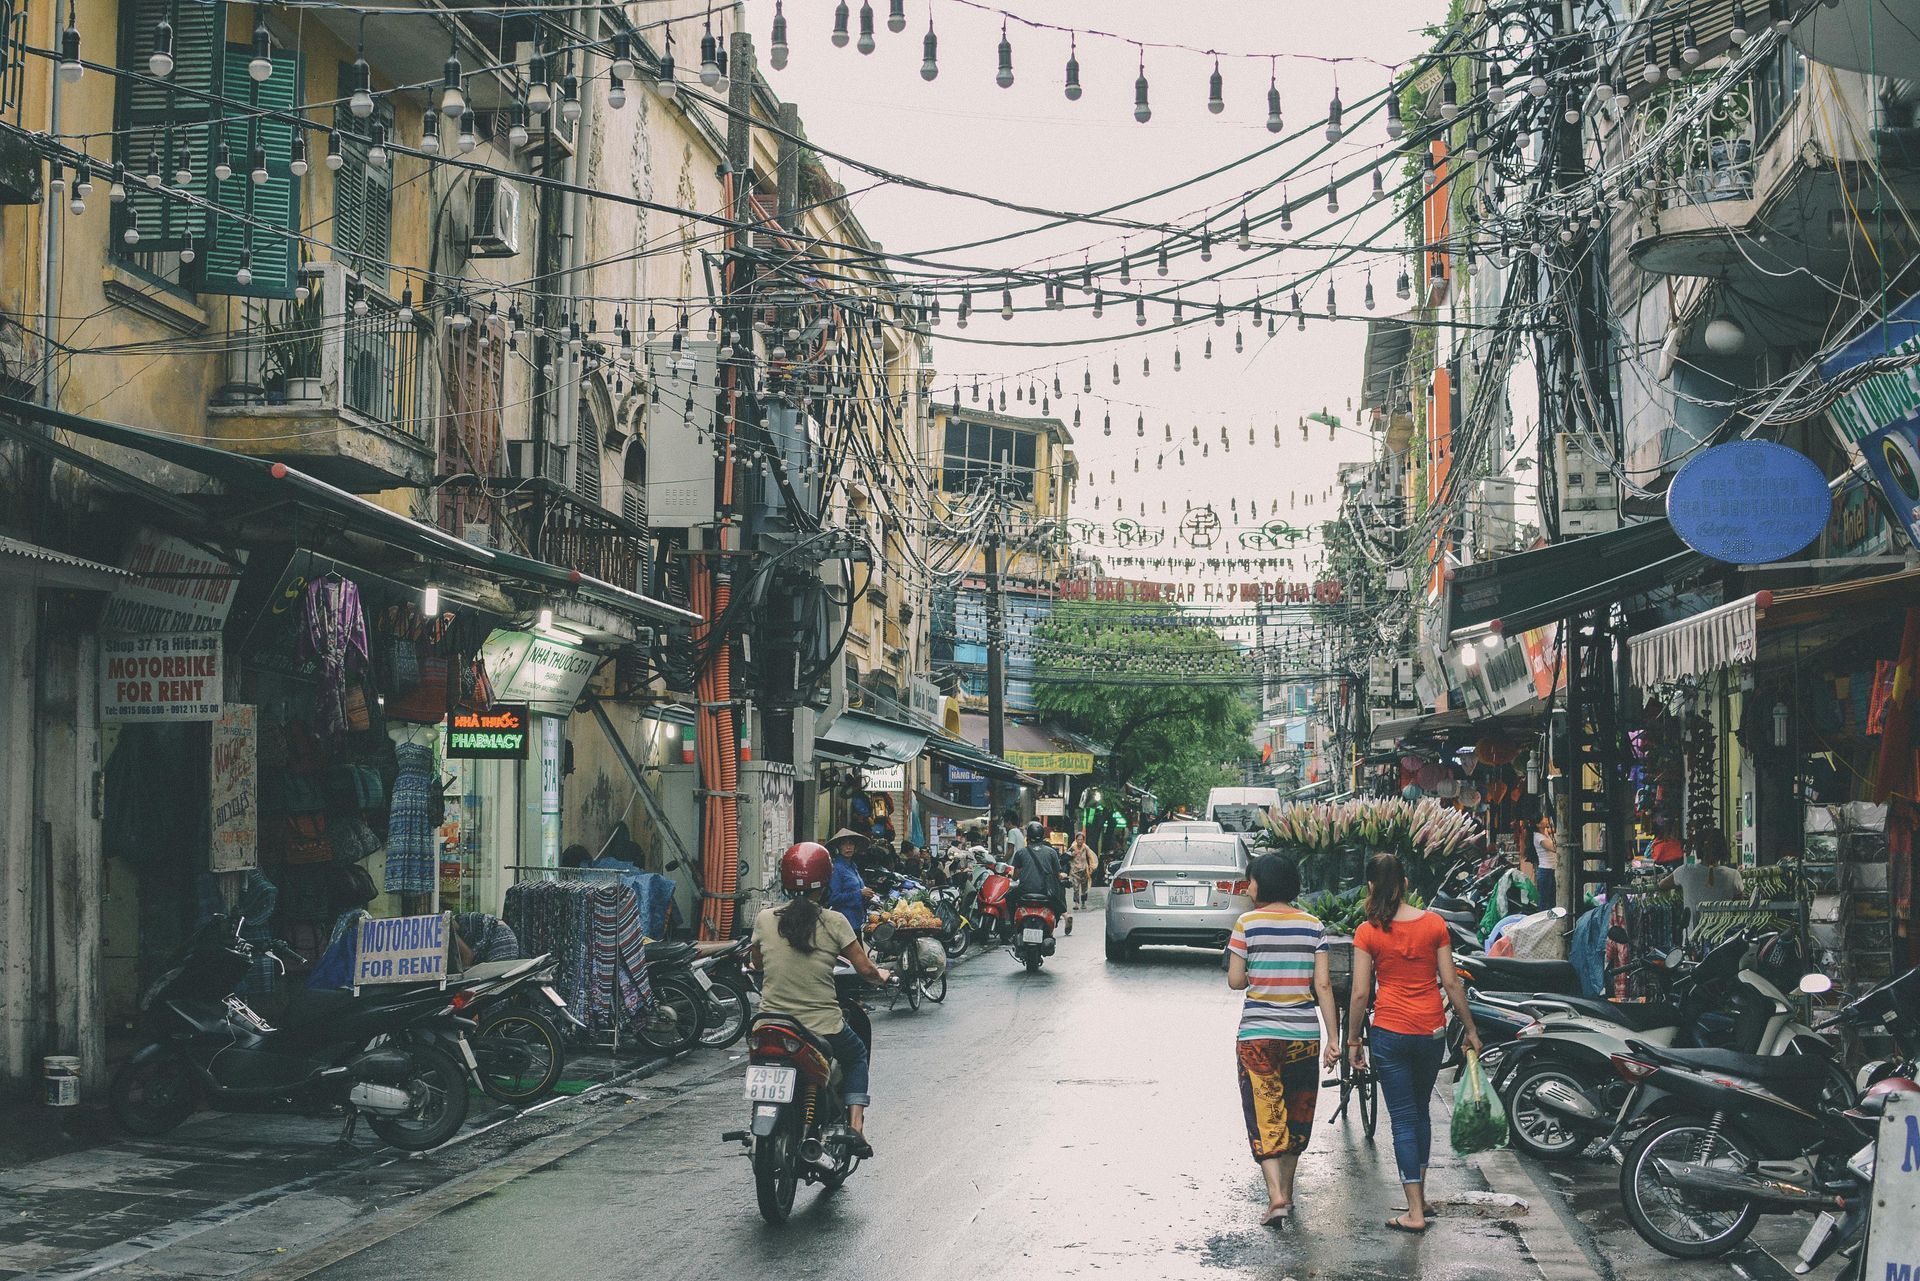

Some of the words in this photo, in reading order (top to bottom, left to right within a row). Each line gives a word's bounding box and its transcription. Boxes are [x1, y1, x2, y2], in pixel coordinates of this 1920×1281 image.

[106, 638, 134, 653] Shop
[138, 638, 152, 651] 37
[108, 655, 216, 679] MOTORBIKE
[117, 681, 152, 702] FOR
[158, 680, 204, 702] RENT
[451, 733, 523, 749] PHARMACY
[544, 758, 557, 792] 37A
[362, 916, 443, 953] MOTORBIKE
[361, 960, 393, 978] FOR
[399, 956, 442, 975] RENT
[751, 1085, 786, 1099] 8105
